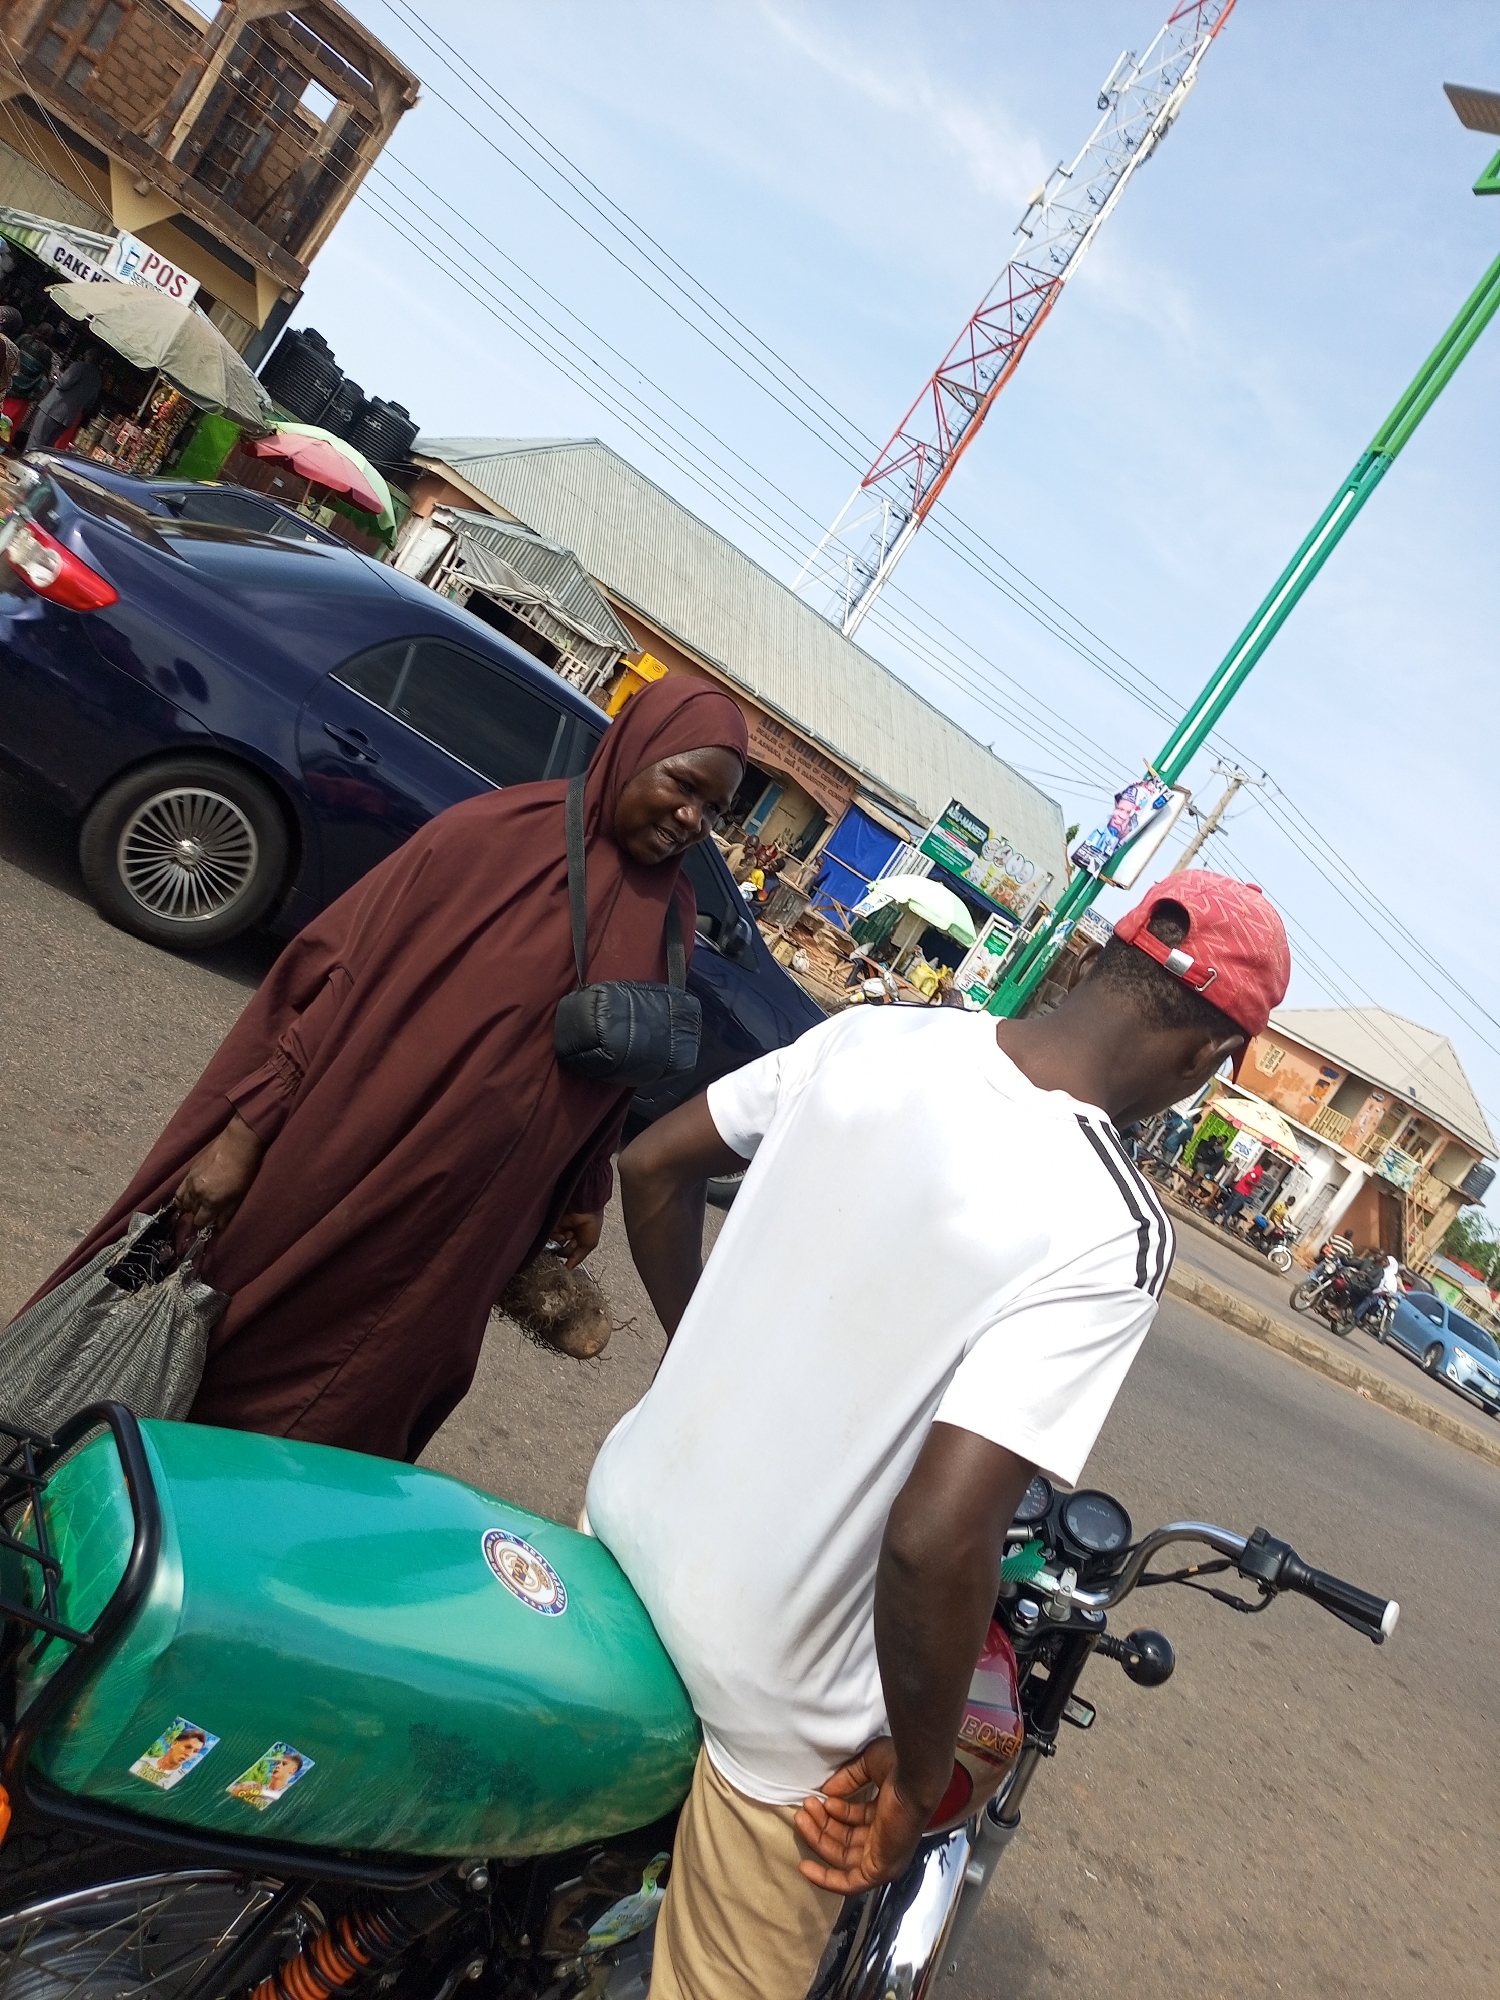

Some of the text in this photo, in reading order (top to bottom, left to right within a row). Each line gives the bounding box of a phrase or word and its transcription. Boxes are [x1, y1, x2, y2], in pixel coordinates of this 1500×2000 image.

[53, 247, 91, 279] CAKE
[141, 253, 188, 298] POS
[756, 726, 779, 746] DEALER
[778, 742, 786, 752] OF
[786, 747, 797, 760] ALL
[812, 765, 821, 775] OF
[522, 1543, 565, 1609] REAL MADRID
